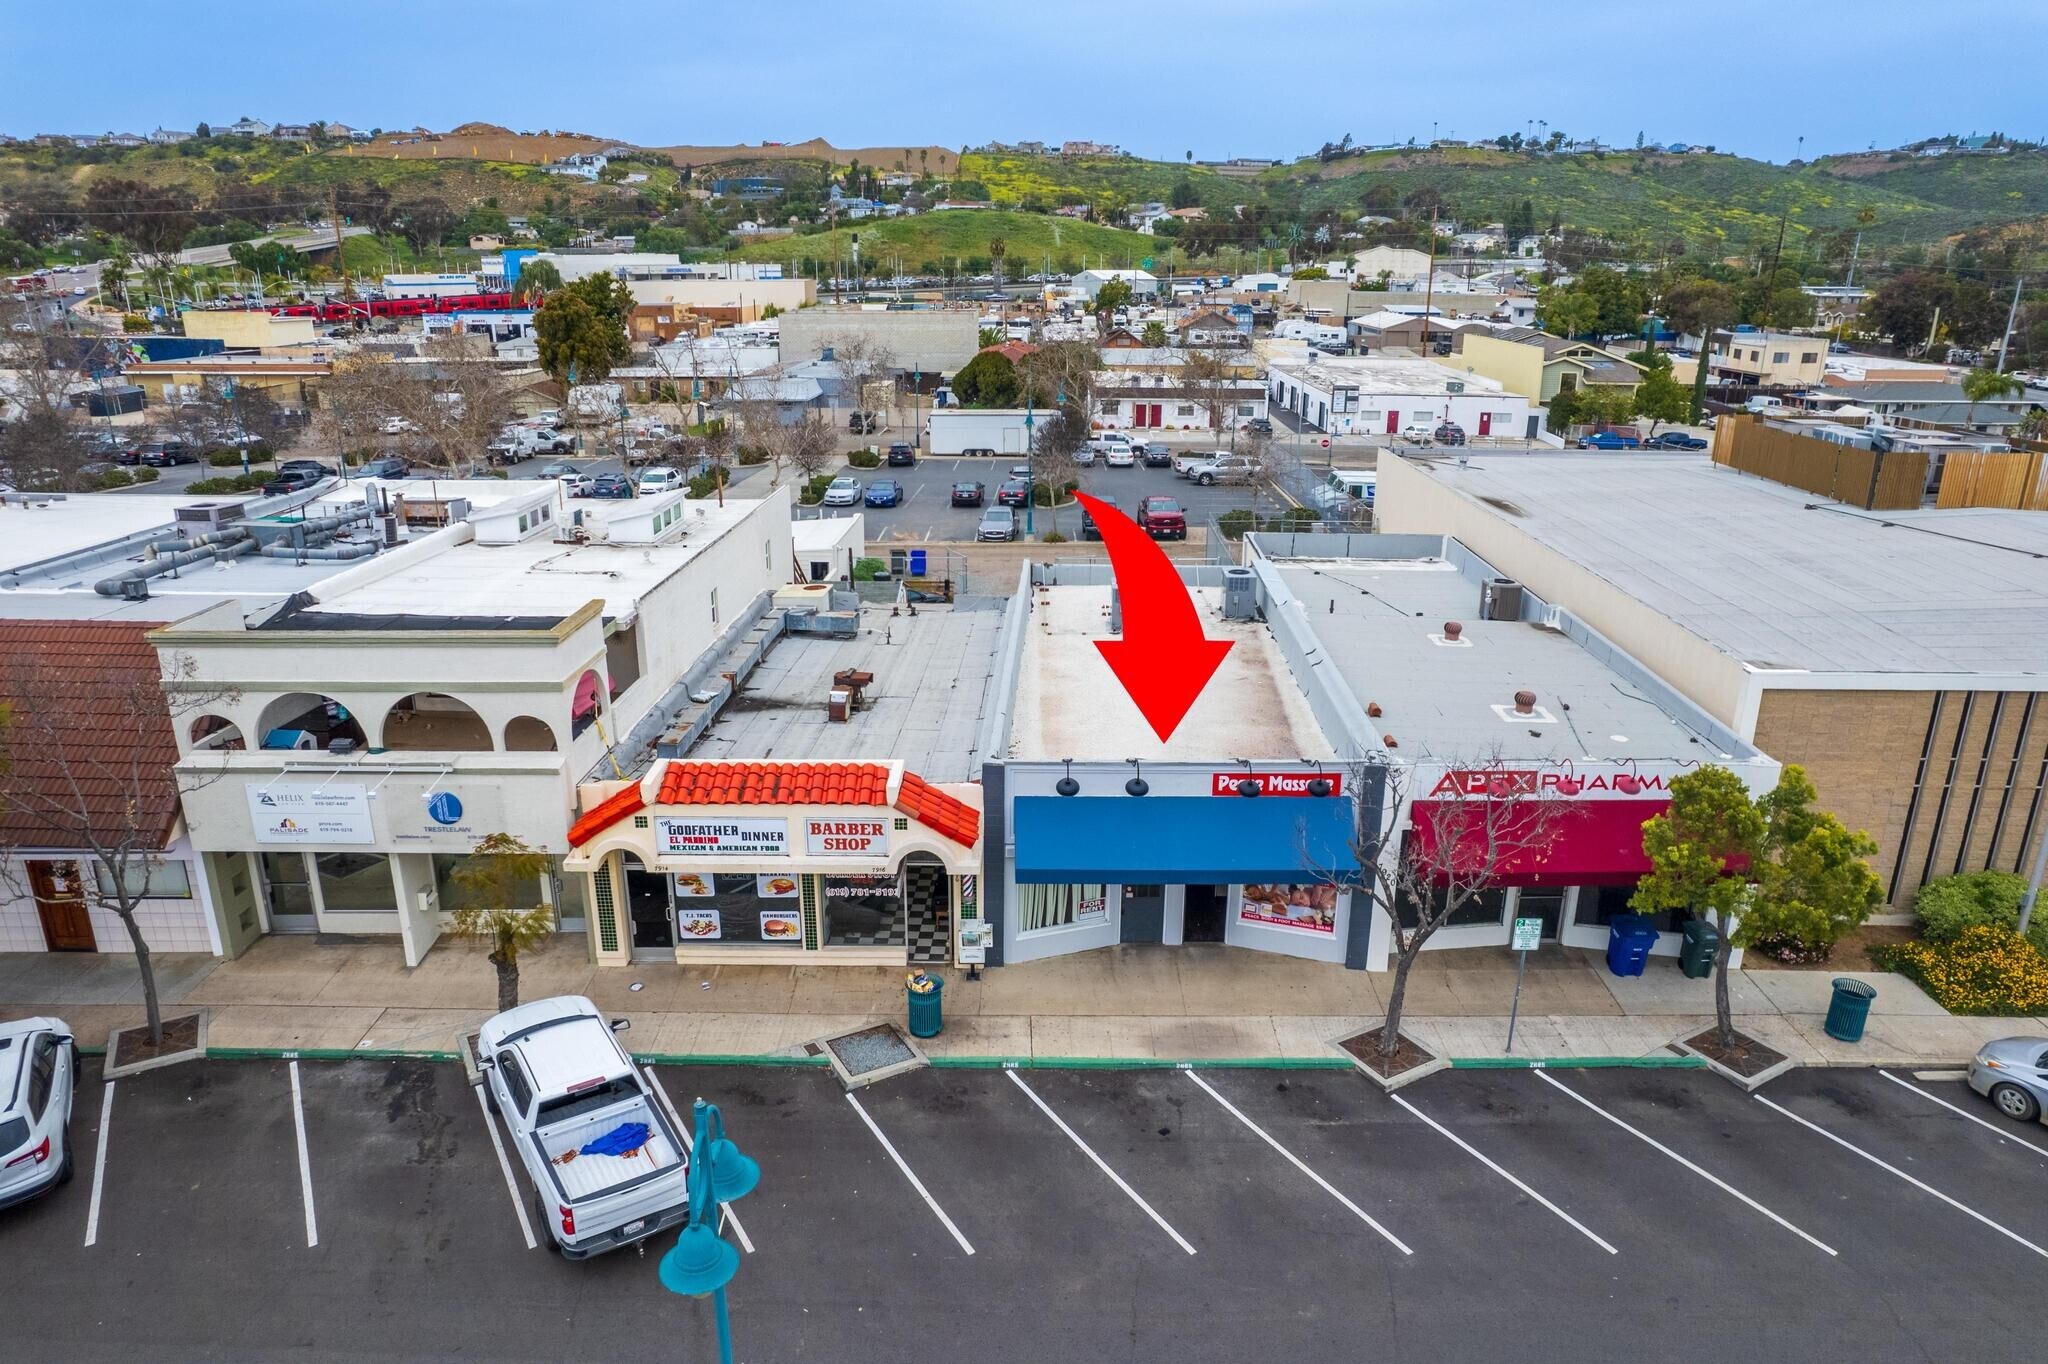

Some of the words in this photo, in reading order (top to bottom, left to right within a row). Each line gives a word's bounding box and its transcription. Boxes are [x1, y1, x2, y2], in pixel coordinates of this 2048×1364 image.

[276, 794, 304, 802] HELIX
[660, 819, 672, 827] THE
[668, 825, 739, 836] GODFATHER
[741, 831, 785, 842] DINNER
[809, 823, 885, 836] BARBER
[669, 836, 681, 844] EL
[823, 837, 872, 851] SHOP
[1082, 900, 1102, 908] FOR
[1080, 905, 1104, 914] RENT
[1292, 920, 1315, 929] MASSAGE
